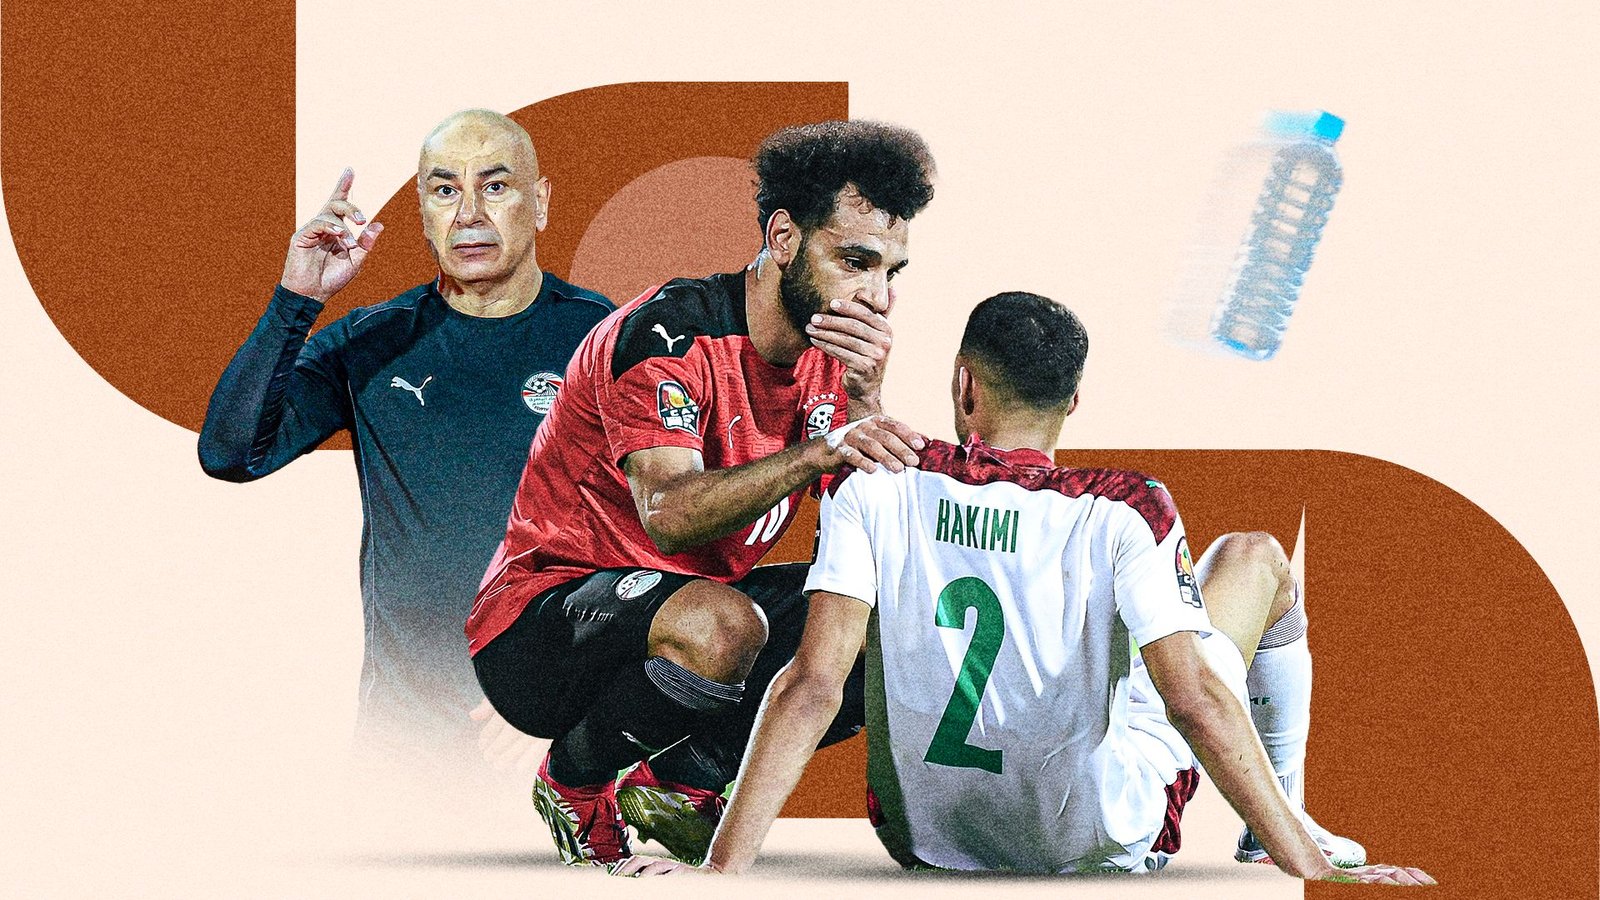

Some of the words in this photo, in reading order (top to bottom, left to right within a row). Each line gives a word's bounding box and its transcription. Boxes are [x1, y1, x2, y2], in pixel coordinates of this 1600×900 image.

[744, 496, 790, 546] 10
[936, 498, 1019, 553] HAKIMI
[924, 576, 1005, 775] 2
